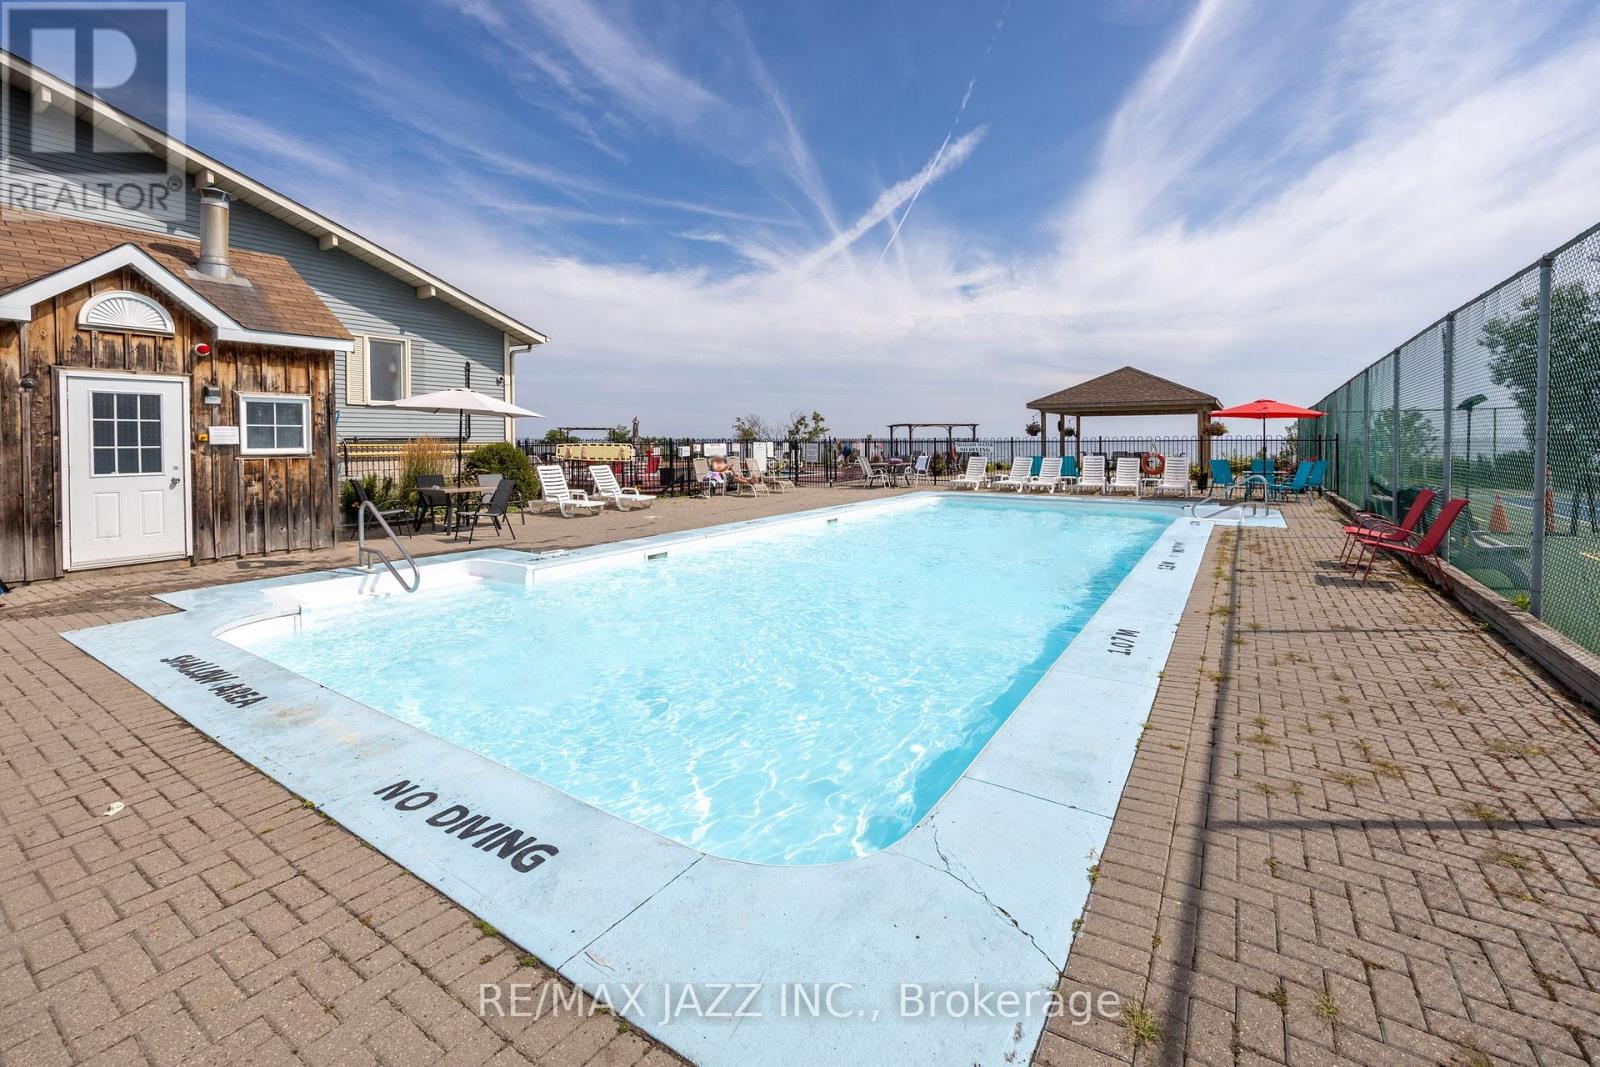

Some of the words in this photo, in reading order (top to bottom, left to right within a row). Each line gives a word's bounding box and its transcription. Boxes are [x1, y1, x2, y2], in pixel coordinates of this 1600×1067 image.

[208, 683, 269, 708] AREA
[373, 779, 438, 811] NO
[425, 804, 560, 874] DIVING
